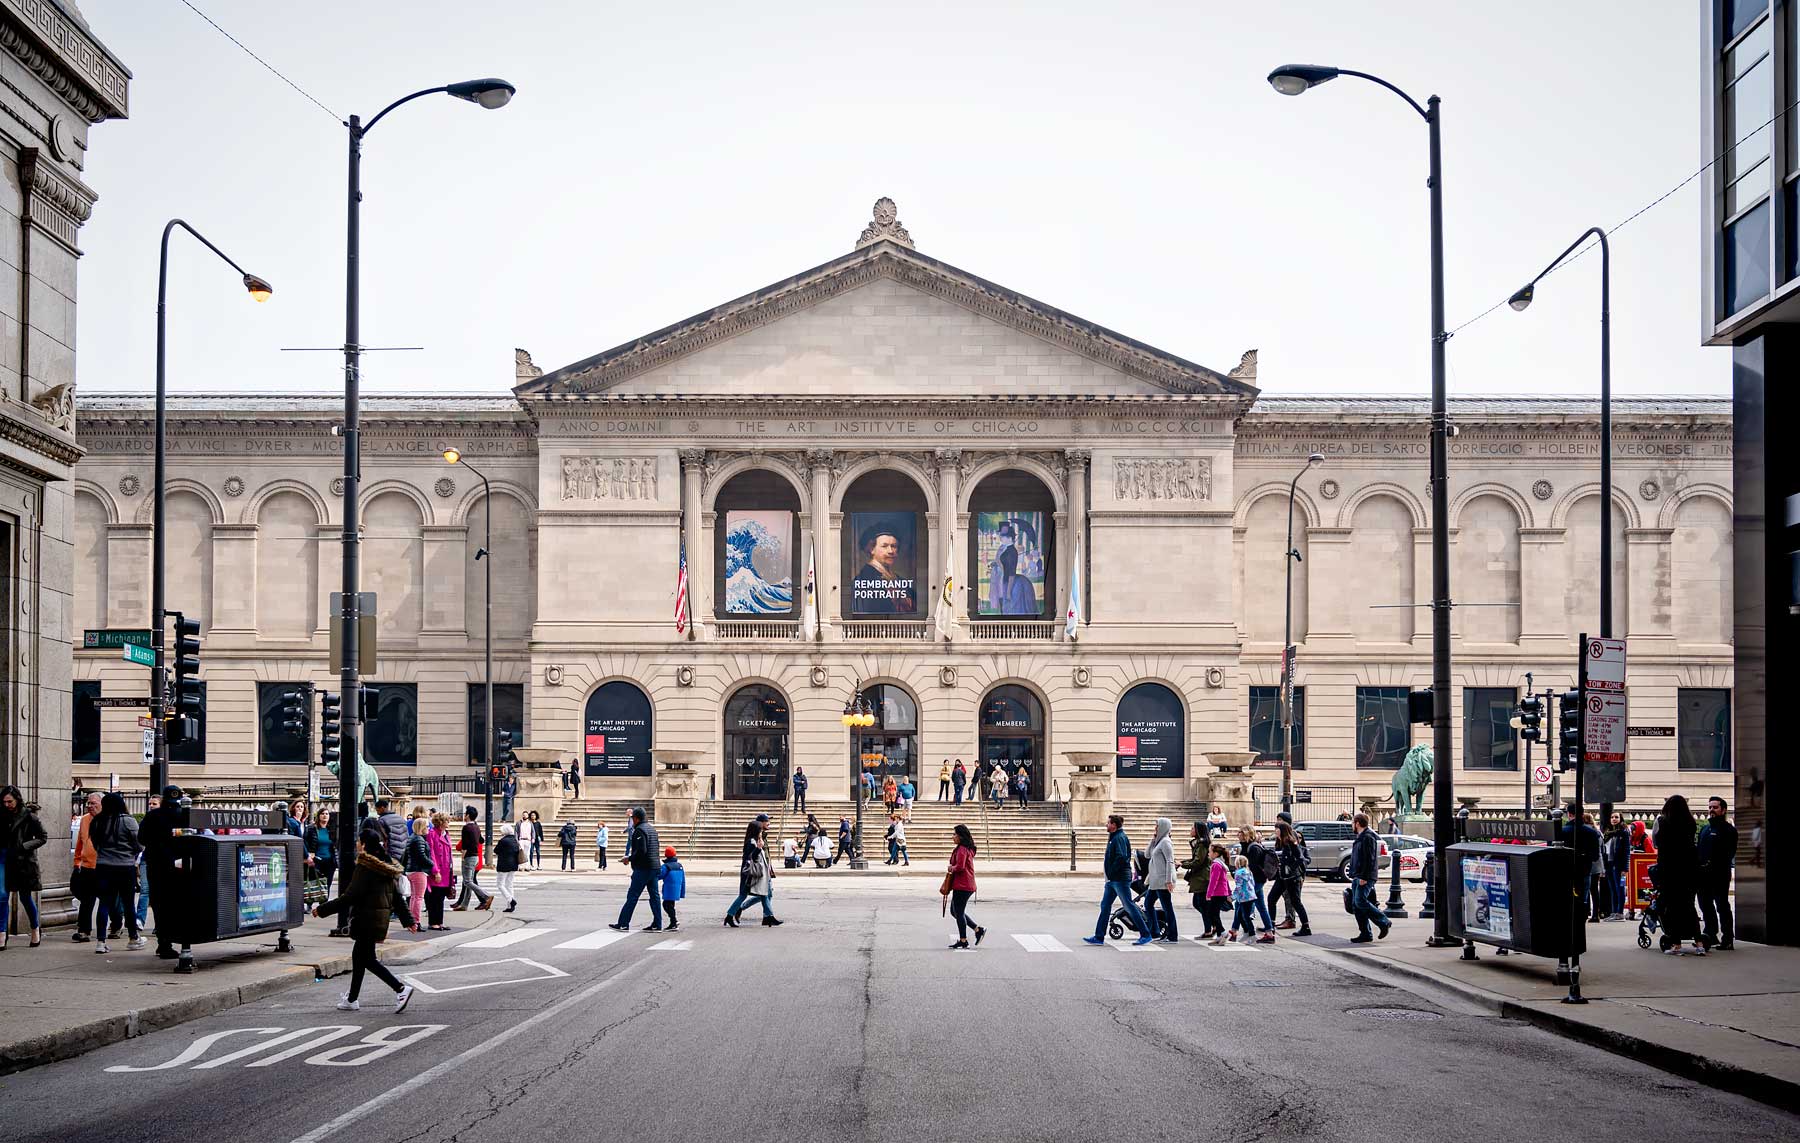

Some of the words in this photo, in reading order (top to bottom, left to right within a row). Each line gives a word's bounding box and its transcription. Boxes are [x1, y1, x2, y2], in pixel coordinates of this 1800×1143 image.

[558, 421, 600, 432] ANNO
[607, 421, 662, 432] DOMINI
[736, 421, 765, 432] THE
[786, 421, 816, 432] ART
[834, 421, 915, 432] INSTITVTE
[934, 421, 954, 432] OF
[972, 421, 1038, 432] CHICAGO
[78, 440, 153, 450] EONARDO
[187, 440, 226, 450] VINCI
[246, 440, 292, 450] DVRER
[385, 440, 447, 451] ANGELO
[467, 441, 535, 452] RAPHAEL
[1238, 443, 1280, 453] TITIAN
[1293, 443, 1345, 453] ANDREA
[1352, 443, 1374, 454] DEL
[1383, 443, 1427, 454] SARTO
[1447, 443, 1522, 454] ORREGGIO
[1538, 443, 1599, 454] HOLBEIN
[1616, 444, 1691, 455] VERONESE
[854, 579, 914, 588] REMBRANDT
[854, 590, 907, 599] PORTRAITS
[105, 633, 141, 644] Michigan
[135, 648, 151, 662] Adams
[1588, 680, 1602, 688] TOW
[1587, 752, 1601, 760] TOW
[210, 812, 269, 826] NEWSPAPERS
[1479, 822, 1537, 837] NEWSPAPERS
[240, 851, 254, 865] Help
[240, 878, 255, 892] Help
[255, 878, 266, 889] You
[103, 1024, 452, 1072] BUS
